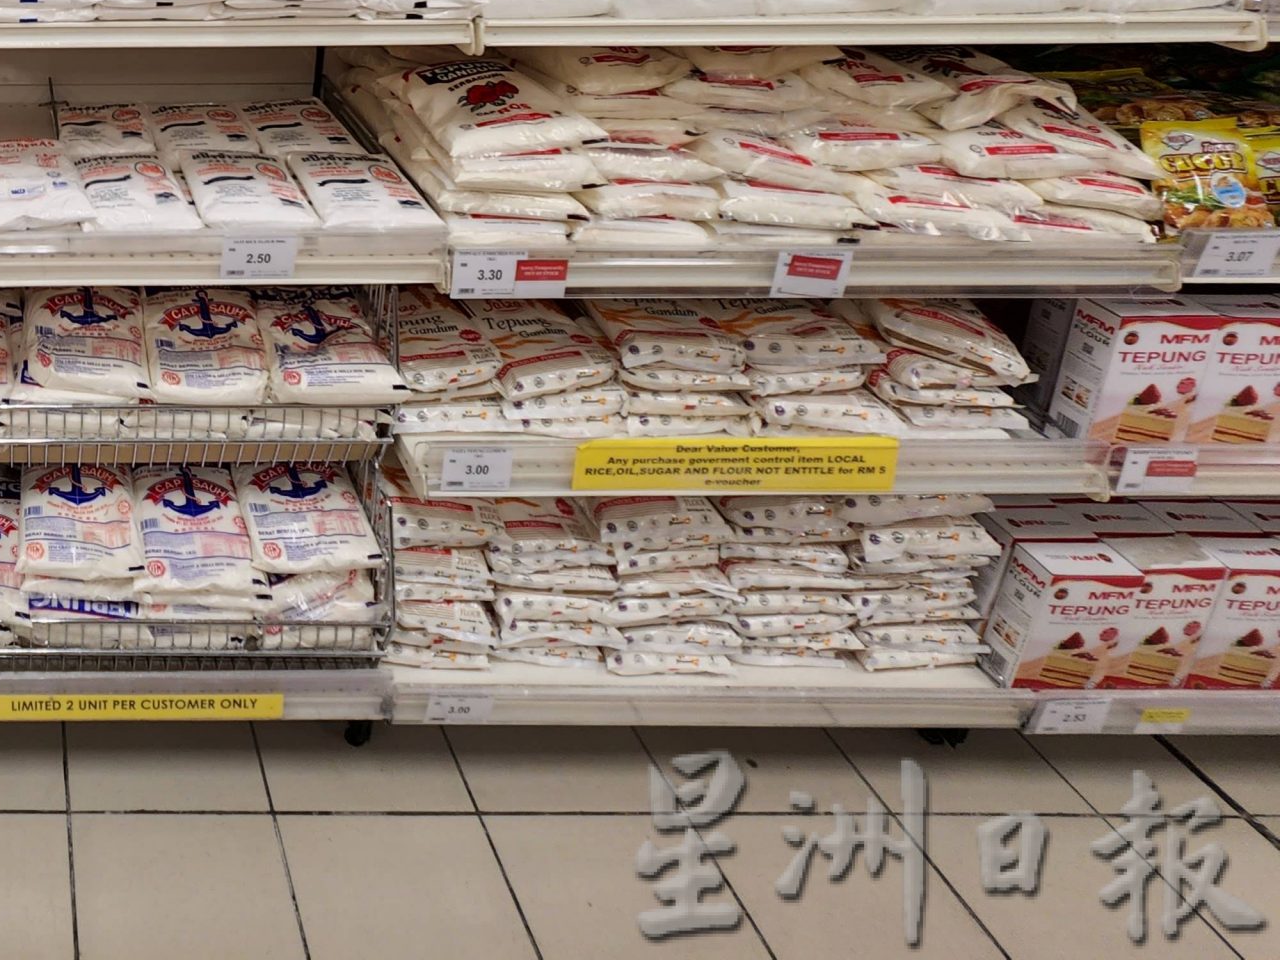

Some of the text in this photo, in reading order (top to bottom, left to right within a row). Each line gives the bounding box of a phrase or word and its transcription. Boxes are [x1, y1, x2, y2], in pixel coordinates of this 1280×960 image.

[246, 253, 271, 264] 2.50
[1225, 251, 1254, 262] 3.07
[477, 269, 503, 281] 3.30
[54, 294, 82, 307] CAP
[171, 304, 243, 320] CAP SAUH
[645, 306, 698, 318] Gandum
[482, 316, 555, 334] Tepung
[1076, 308, 1115, 335] MFM
[409, 324, 458, 336] Gandum
[520, 327, 568, 339] Gandum
[1074, 323, 1110, 346] FLOUR
[1161, 334, 1210, 344] MFM
[1118, 350, 1206, 363] TEPUNG
[676, 445, 801, 454] Dear Value Customer,
[607, 456, 628, 466] Any
[632, 456, 685, 465] purchase
[753, 455, 795, 464] control
[798, 455, 824, 463] item
[827, 455, 865, 463] LOCAL
[43, 466, 114, 481] CAP SAUH
[259, 463, 331, 481] CAP SAUH
[465, 465, 489, 475] 3.00
[584, 467, 681, 476] RICE,OIL,SUGAR
[684, 467, 709, 475] AND
[713, 467, 752, 475] FLOUR
[756, 467, 780, 475] NOT
[838, 466, 854, 474] for
[857, 466, 876, 474] RM
[705, 478, 762, 486] e-voucher
[153, 478, 227, 499] CAP SAUH
[1011, 557, 1046, 589] MFM
[1172, 584, 1216, 593] MFM
[1089, 592, 1134, 600] MFM
[1049, 604, 1130, 616] TEPUNG
[1135, 598, 1211, 610] TEPUNG
[11, 698, 258, 711] LIMITED 2 UNIT PER CUSTOMER ONLY
[448, 706, 471, 714] 3.00
